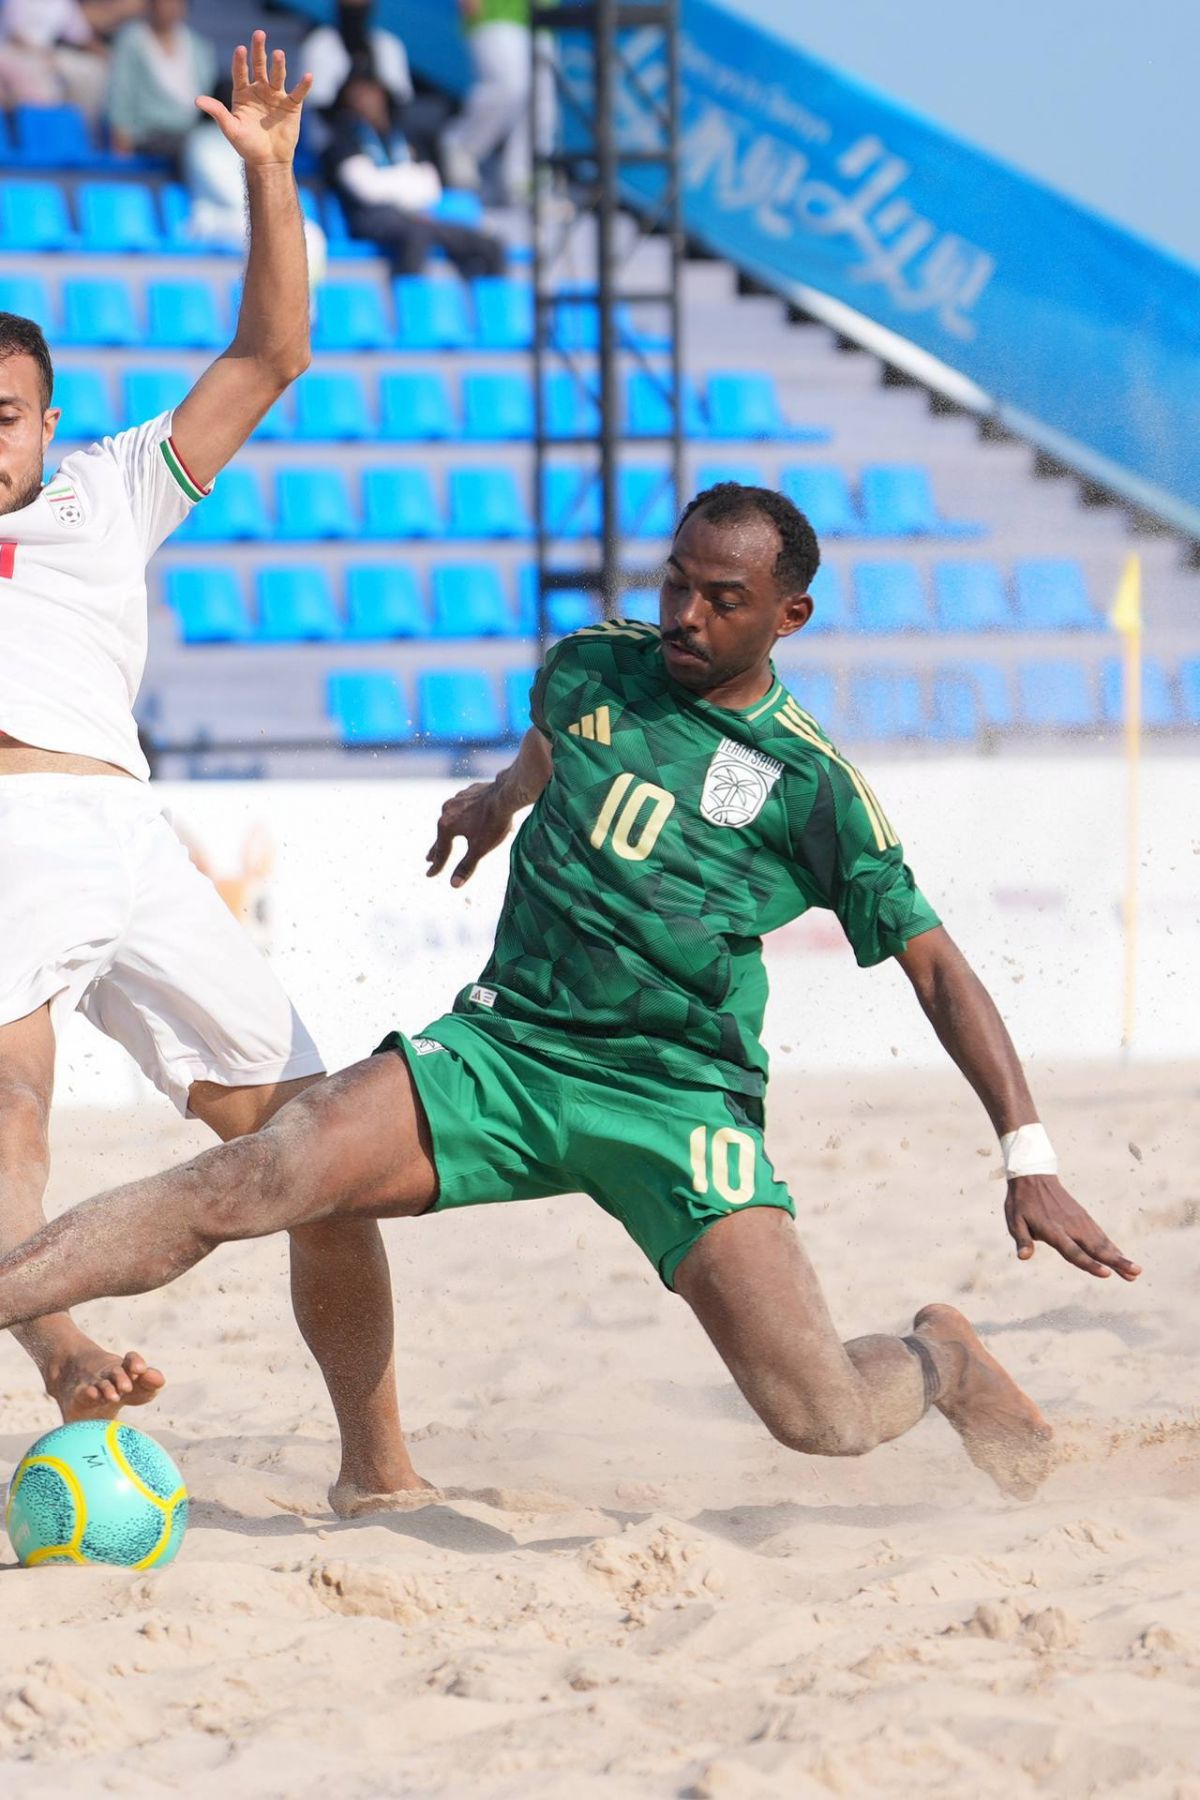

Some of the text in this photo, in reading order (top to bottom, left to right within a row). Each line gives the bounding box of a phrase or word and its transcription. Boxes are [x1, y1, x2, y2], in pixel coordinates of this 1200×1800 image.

[720, 738, 750, 761] TEAM
[590, 772, 675, 861] 10
[689, 1125, 756, 1205] 10
